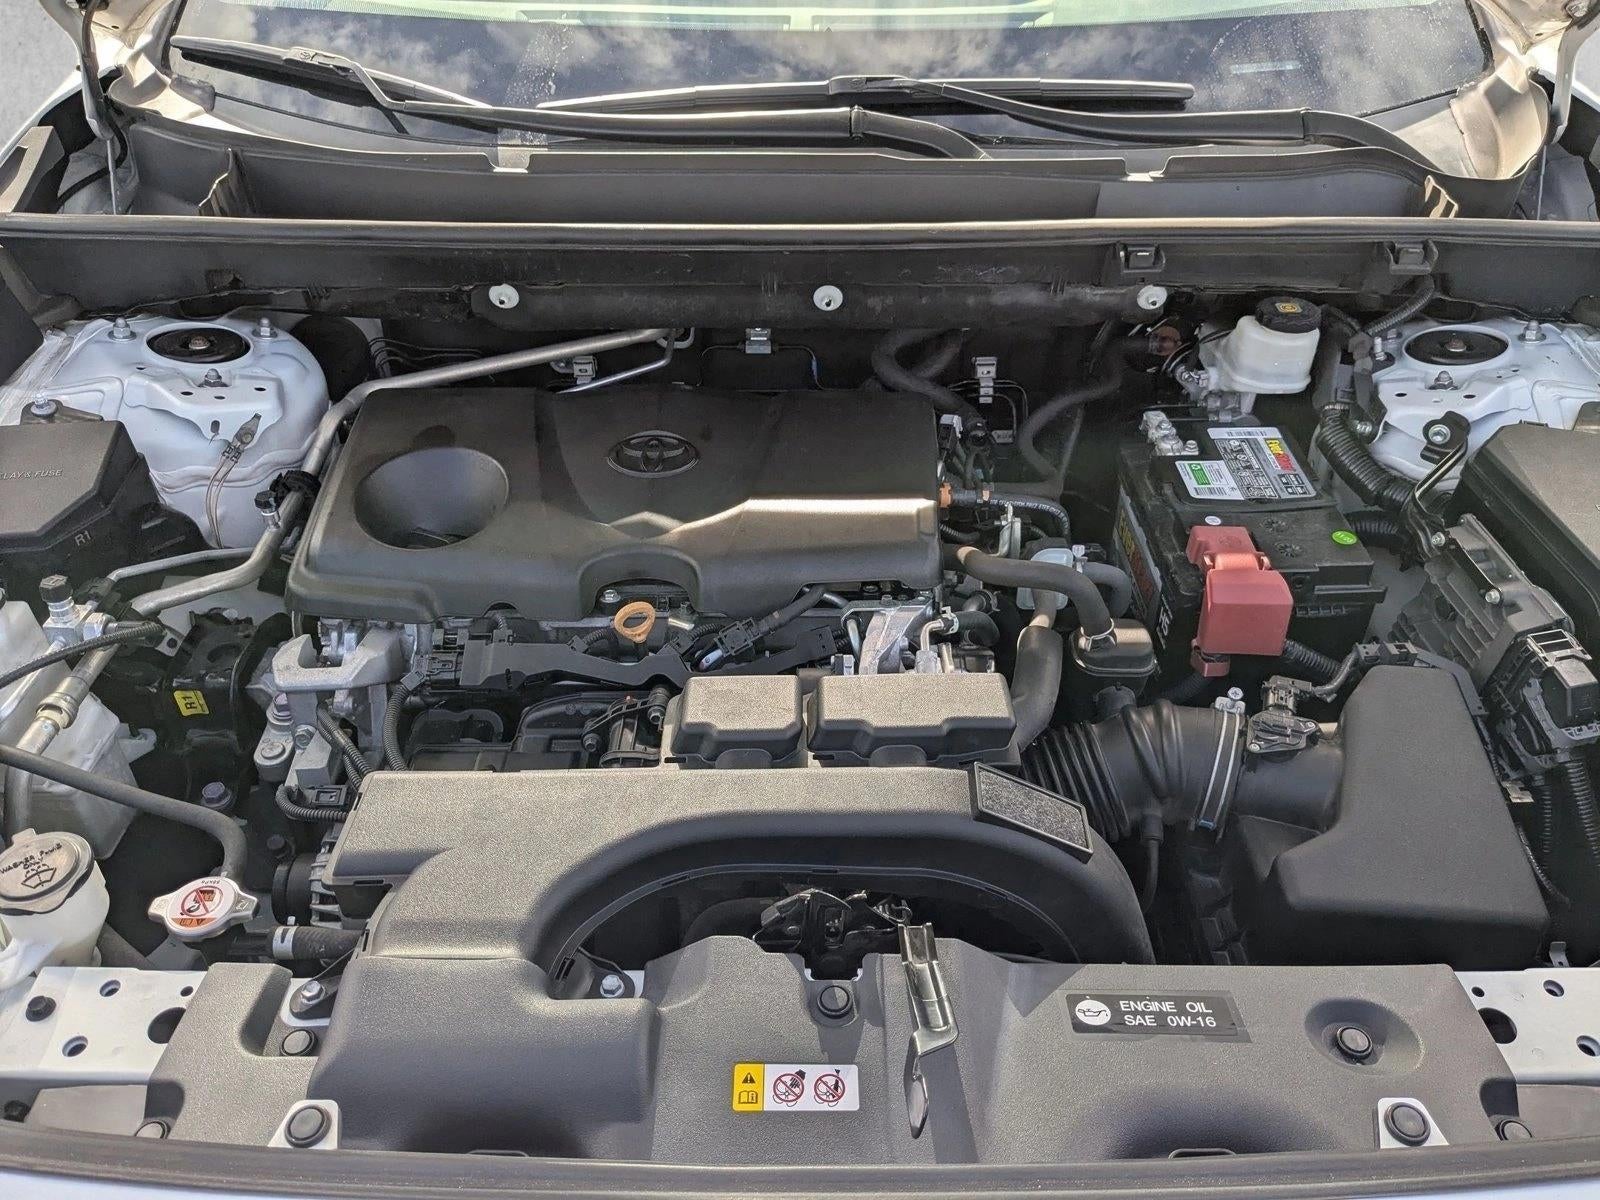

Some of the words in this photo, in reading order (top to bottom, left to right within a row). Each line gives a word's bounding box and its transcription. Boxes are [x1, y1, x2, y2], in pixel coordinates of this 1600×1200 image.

[35, 468, 63, 478] FUSE
[75, 530, 91, 546] R1
[182, 696, 197, 710] R1
[1119, 1000, 1177, 1012] ENGINE
[1185, 1002, 1213, 1013] OIL
[1124, 1015, 1157, 1026] SAE
[1167, 1015, 1217, 1027] 0W-16
